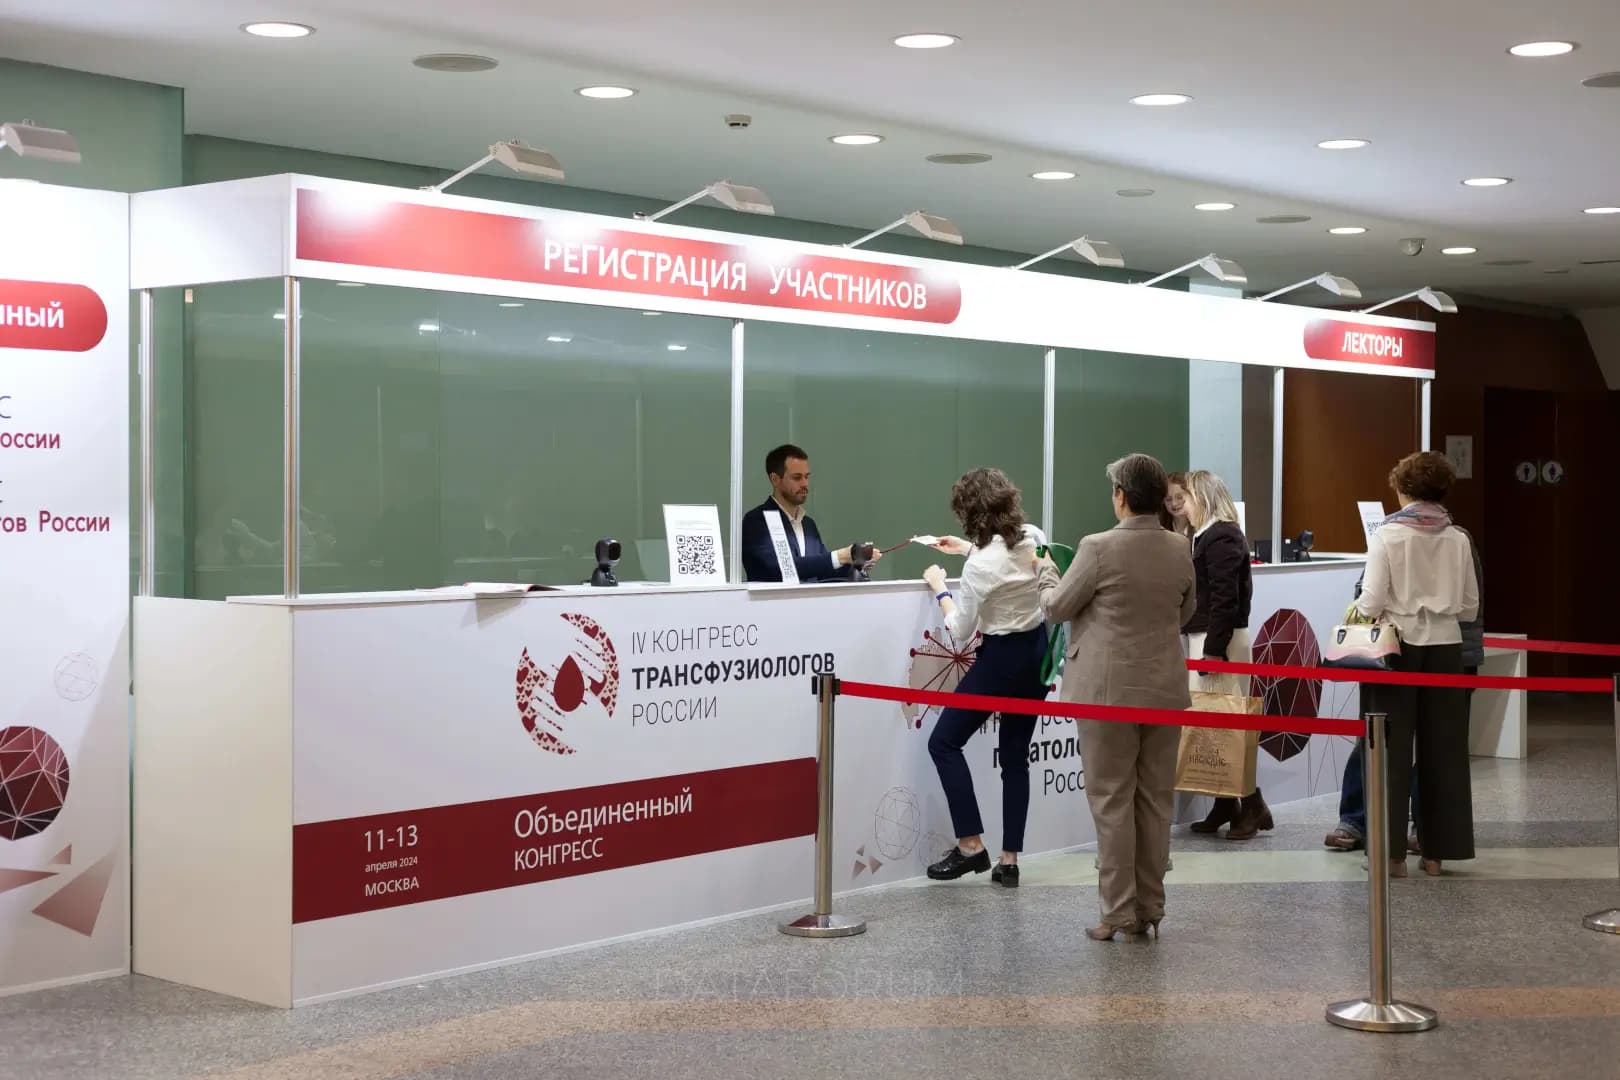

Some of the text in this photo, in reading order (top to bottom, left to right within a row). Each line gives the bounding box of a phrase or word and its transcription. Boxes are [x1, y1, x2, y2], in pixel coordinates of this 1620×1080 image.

[543, 239, 928, 310] РЕГИСТРАЦИЯ УЧАСТНИКОВ
[1341, 331, 1403, 358] ЛЕКТОРЫ
[38, 510, 111, 533] России
[631, 624, 759, 655] IV КОНГРЕСС
[631, 652, 835, 691] ТРАНСФУЗИОЛОГОВ
[631, 696, 718, 728] РОССИИ
[513, 787, 693, 839] Объединенный
[364, 824, 419, 853] 11-13
[513, 837, 604, 871] КОНГРЕСС
[364, 855, 418, 873] апреля 2024
[364, 876, 420, 897] МОСКВА
